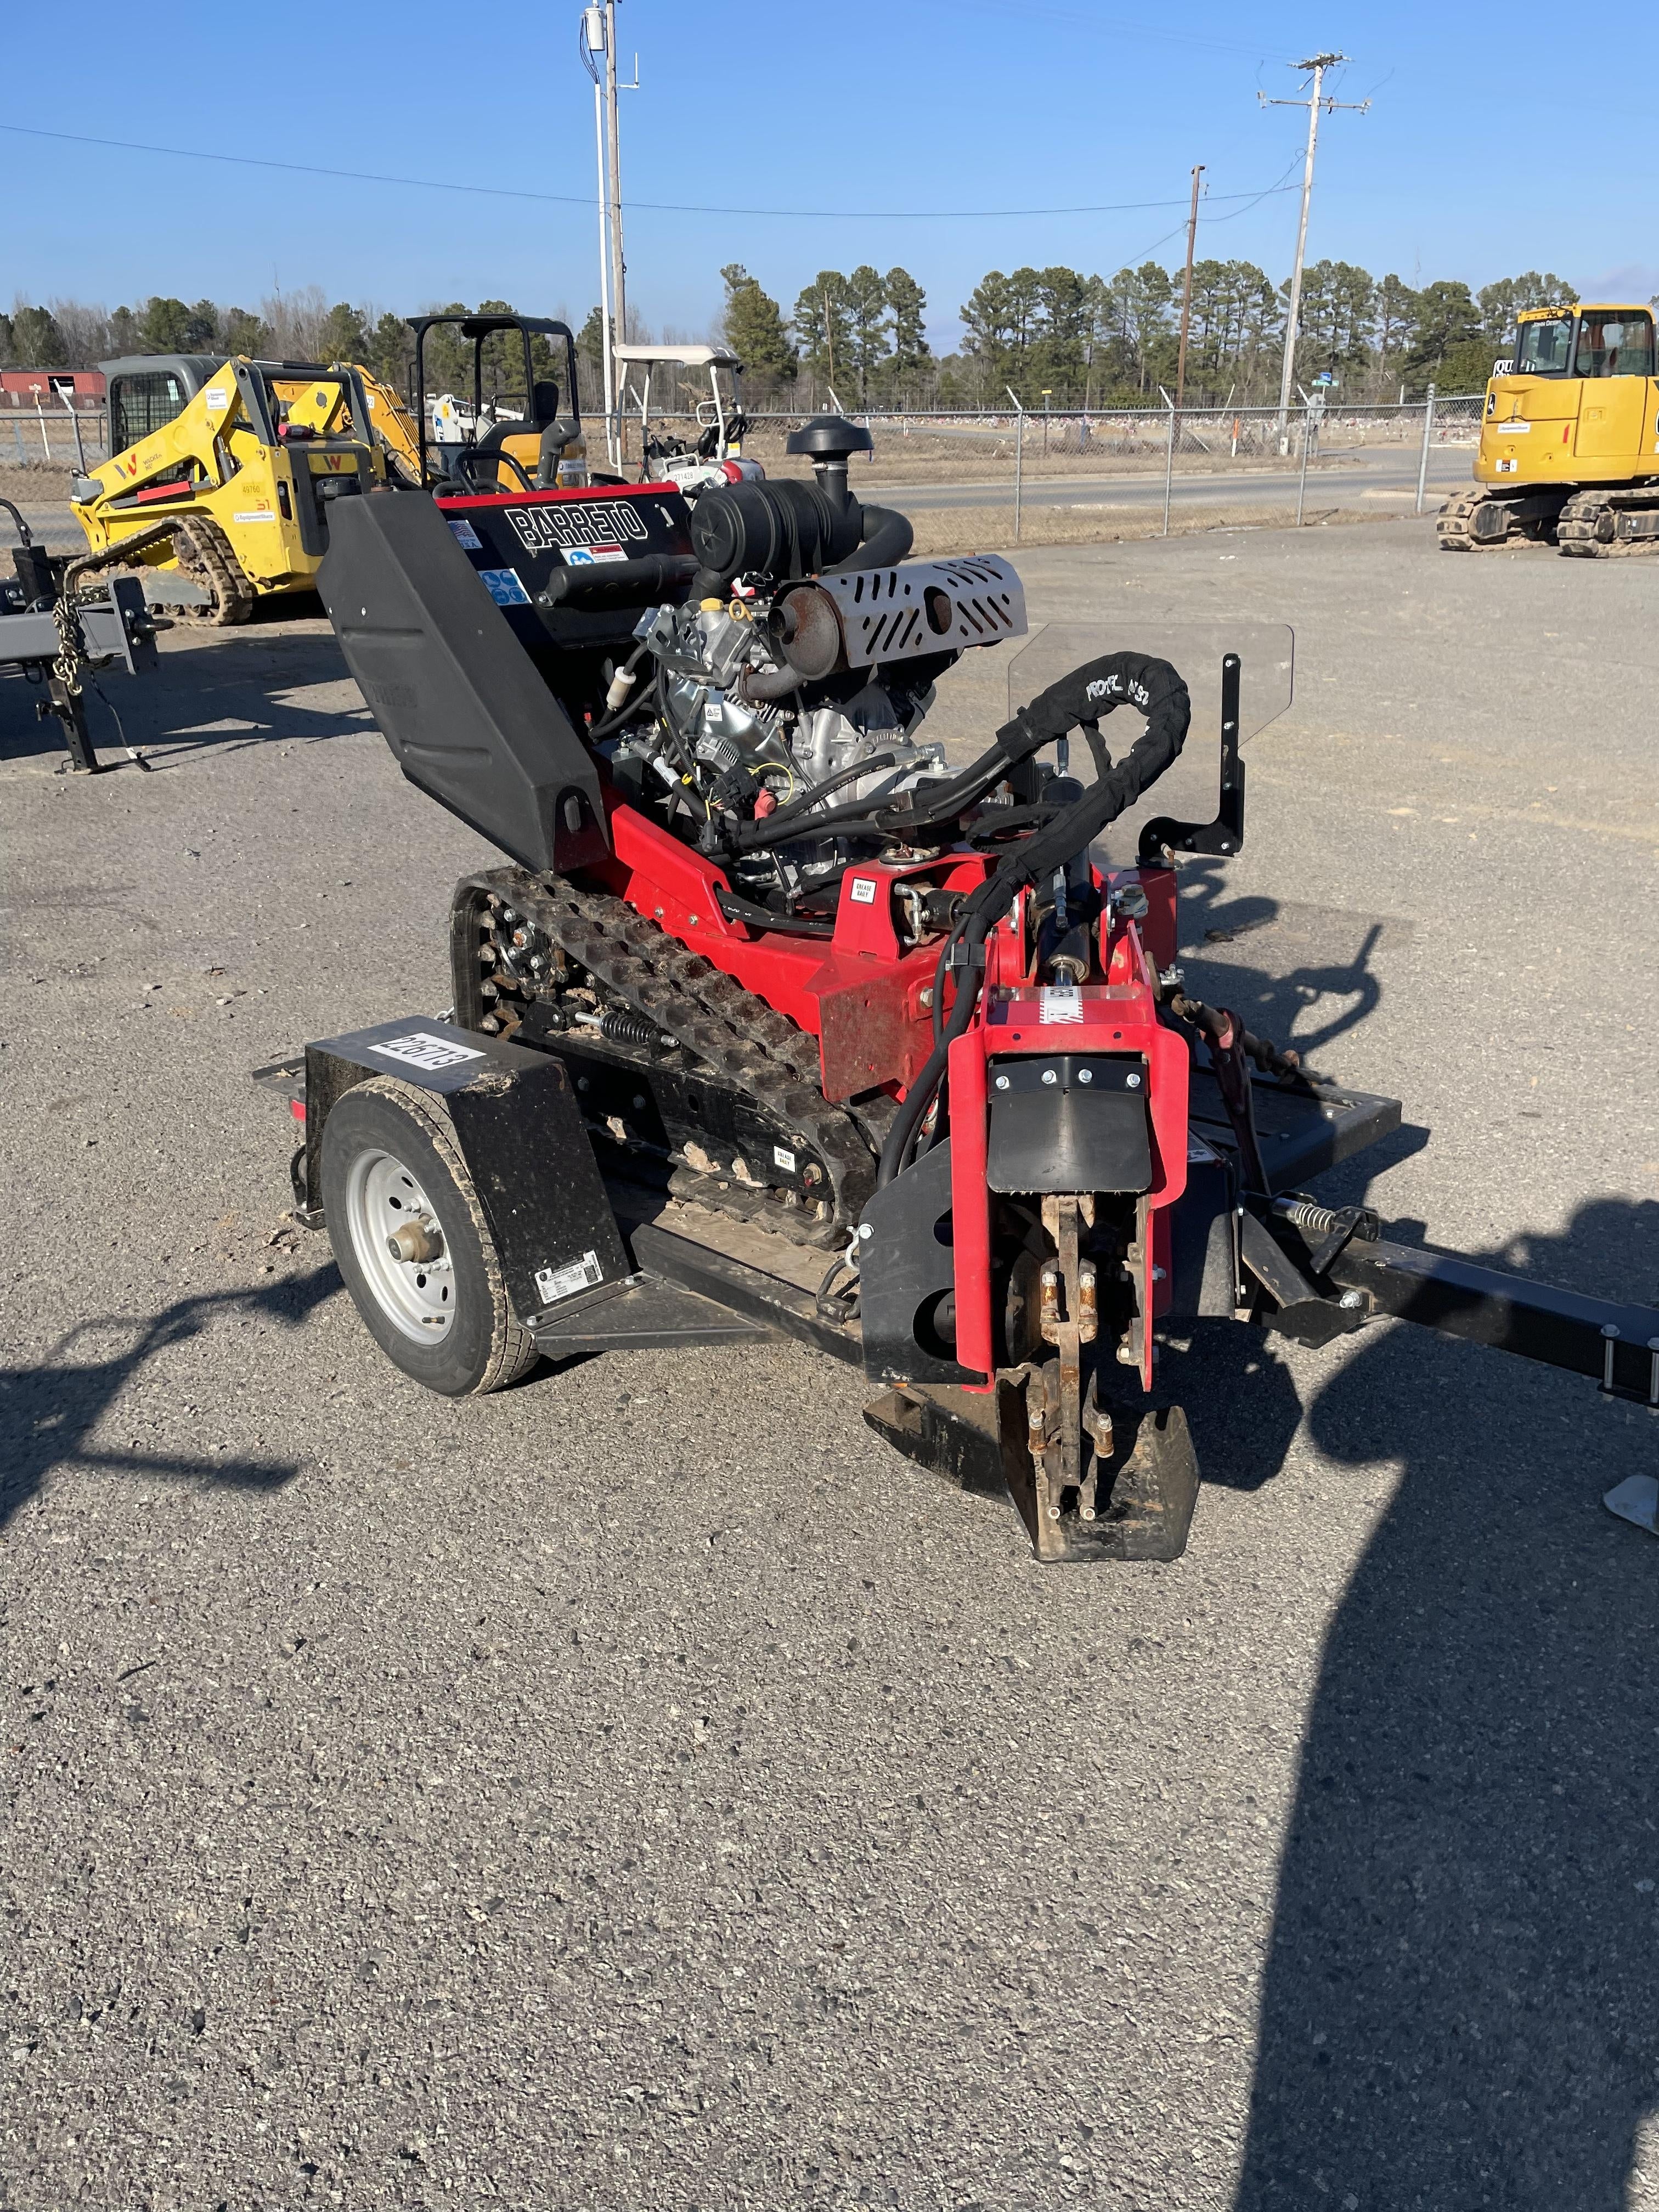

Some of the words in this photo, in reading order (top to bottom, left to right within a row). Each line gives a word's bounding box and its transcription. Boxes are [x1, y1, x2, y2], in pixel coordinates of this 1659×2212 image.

[675, 472, 693, 481] 271428
[242, 485, 260, 493] 49760
[504, 501, 648, 549] BARRETO
[380, 1037, 469, 1065] 226713
